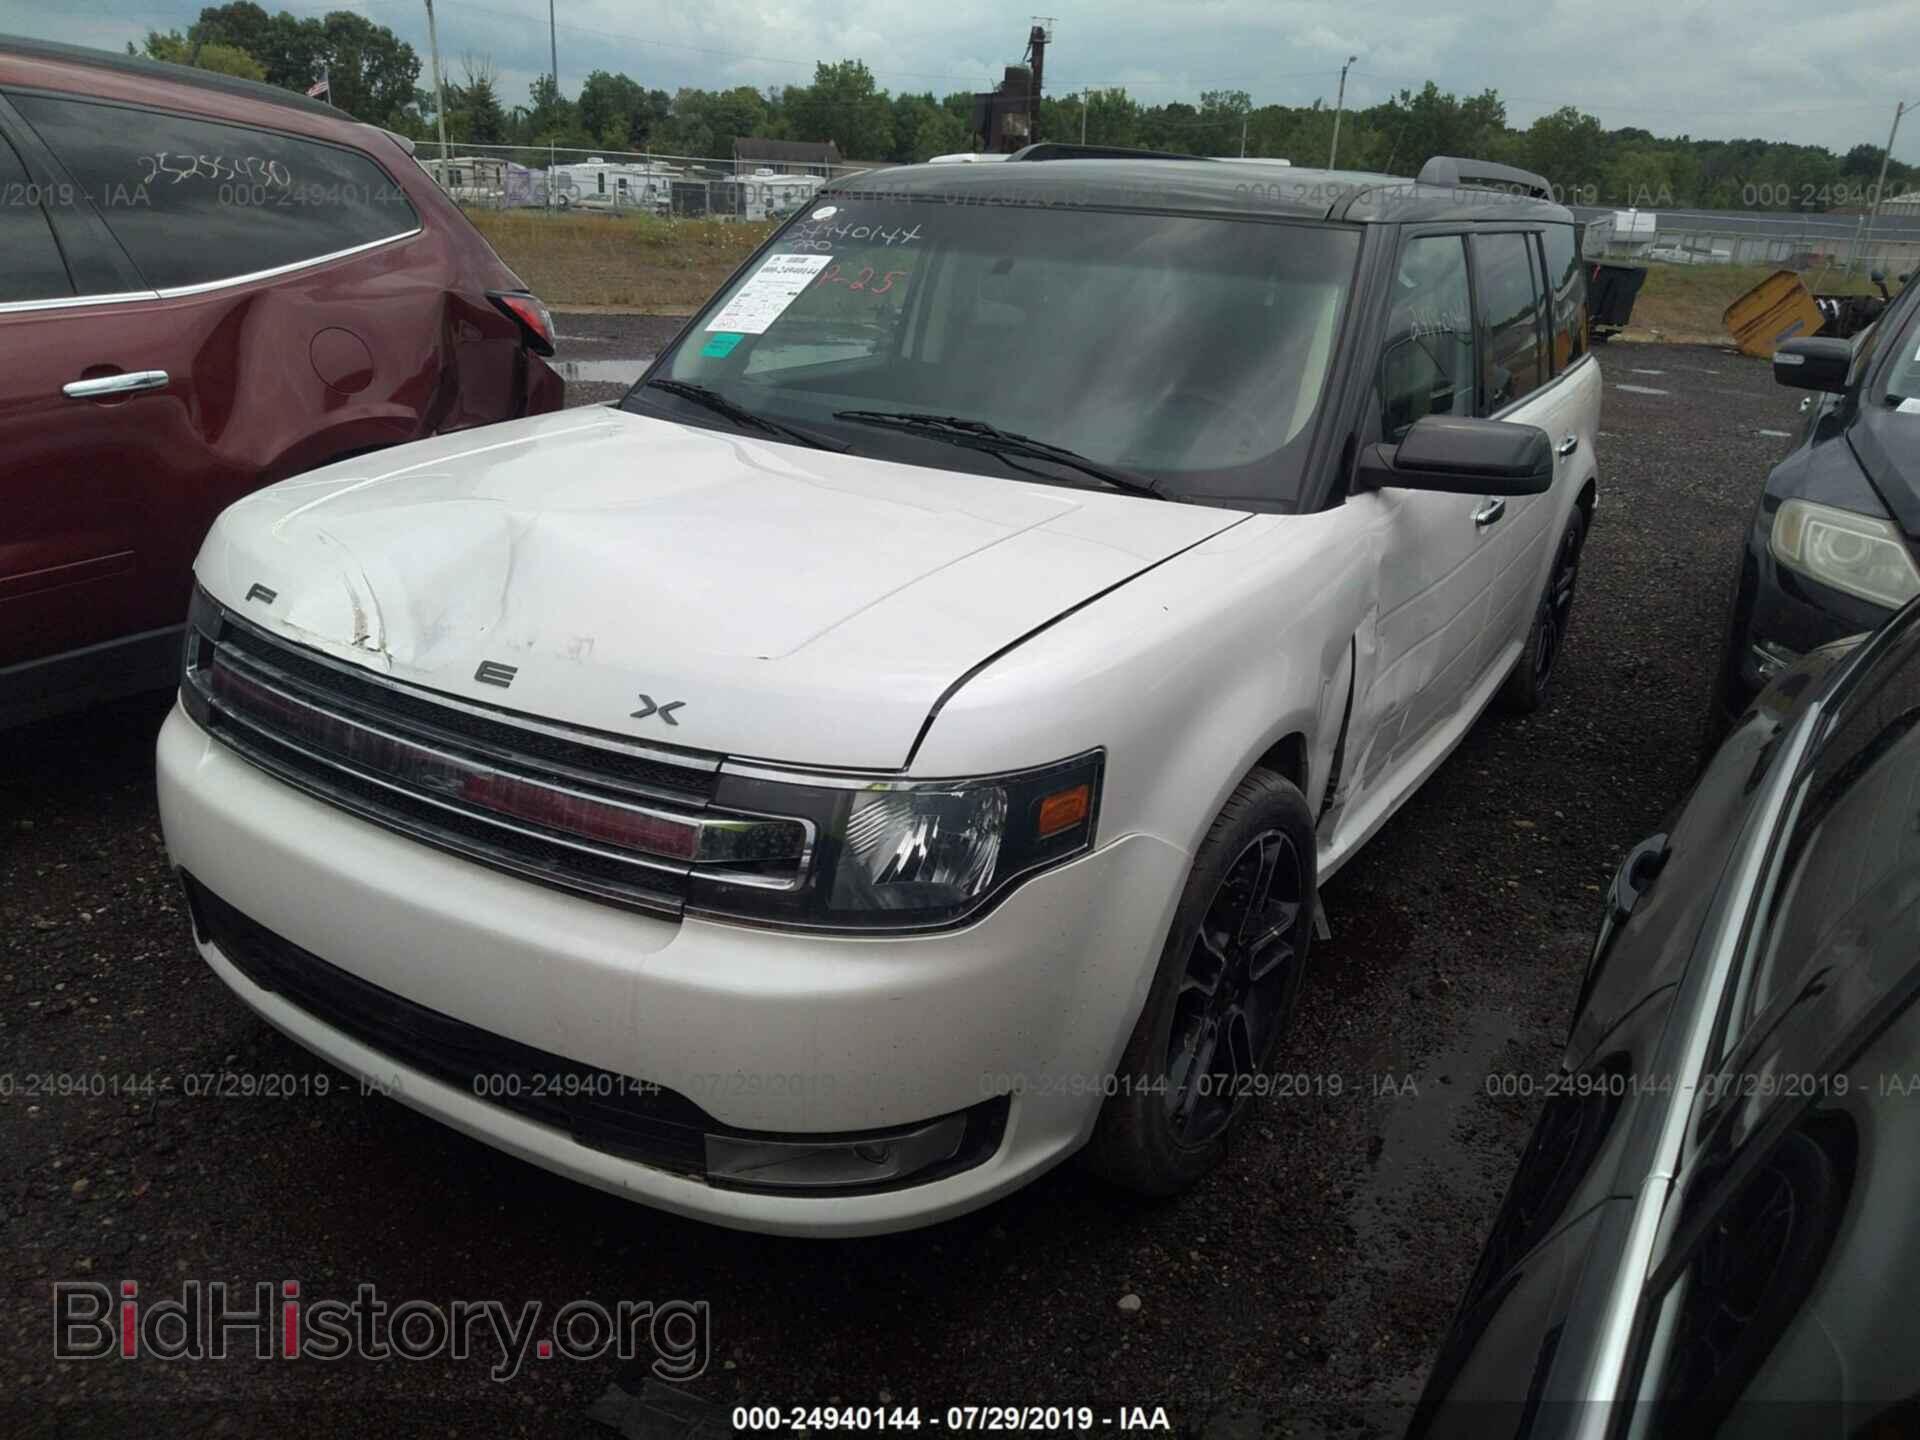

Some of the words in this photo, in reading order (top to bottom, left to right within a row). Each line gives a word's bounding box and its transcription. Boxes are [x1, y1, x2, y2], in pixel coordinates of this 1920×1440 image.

[246, 583, 278, 605] F
[474, 660, 519, 689] E
[630, 694, 687, 726] X
